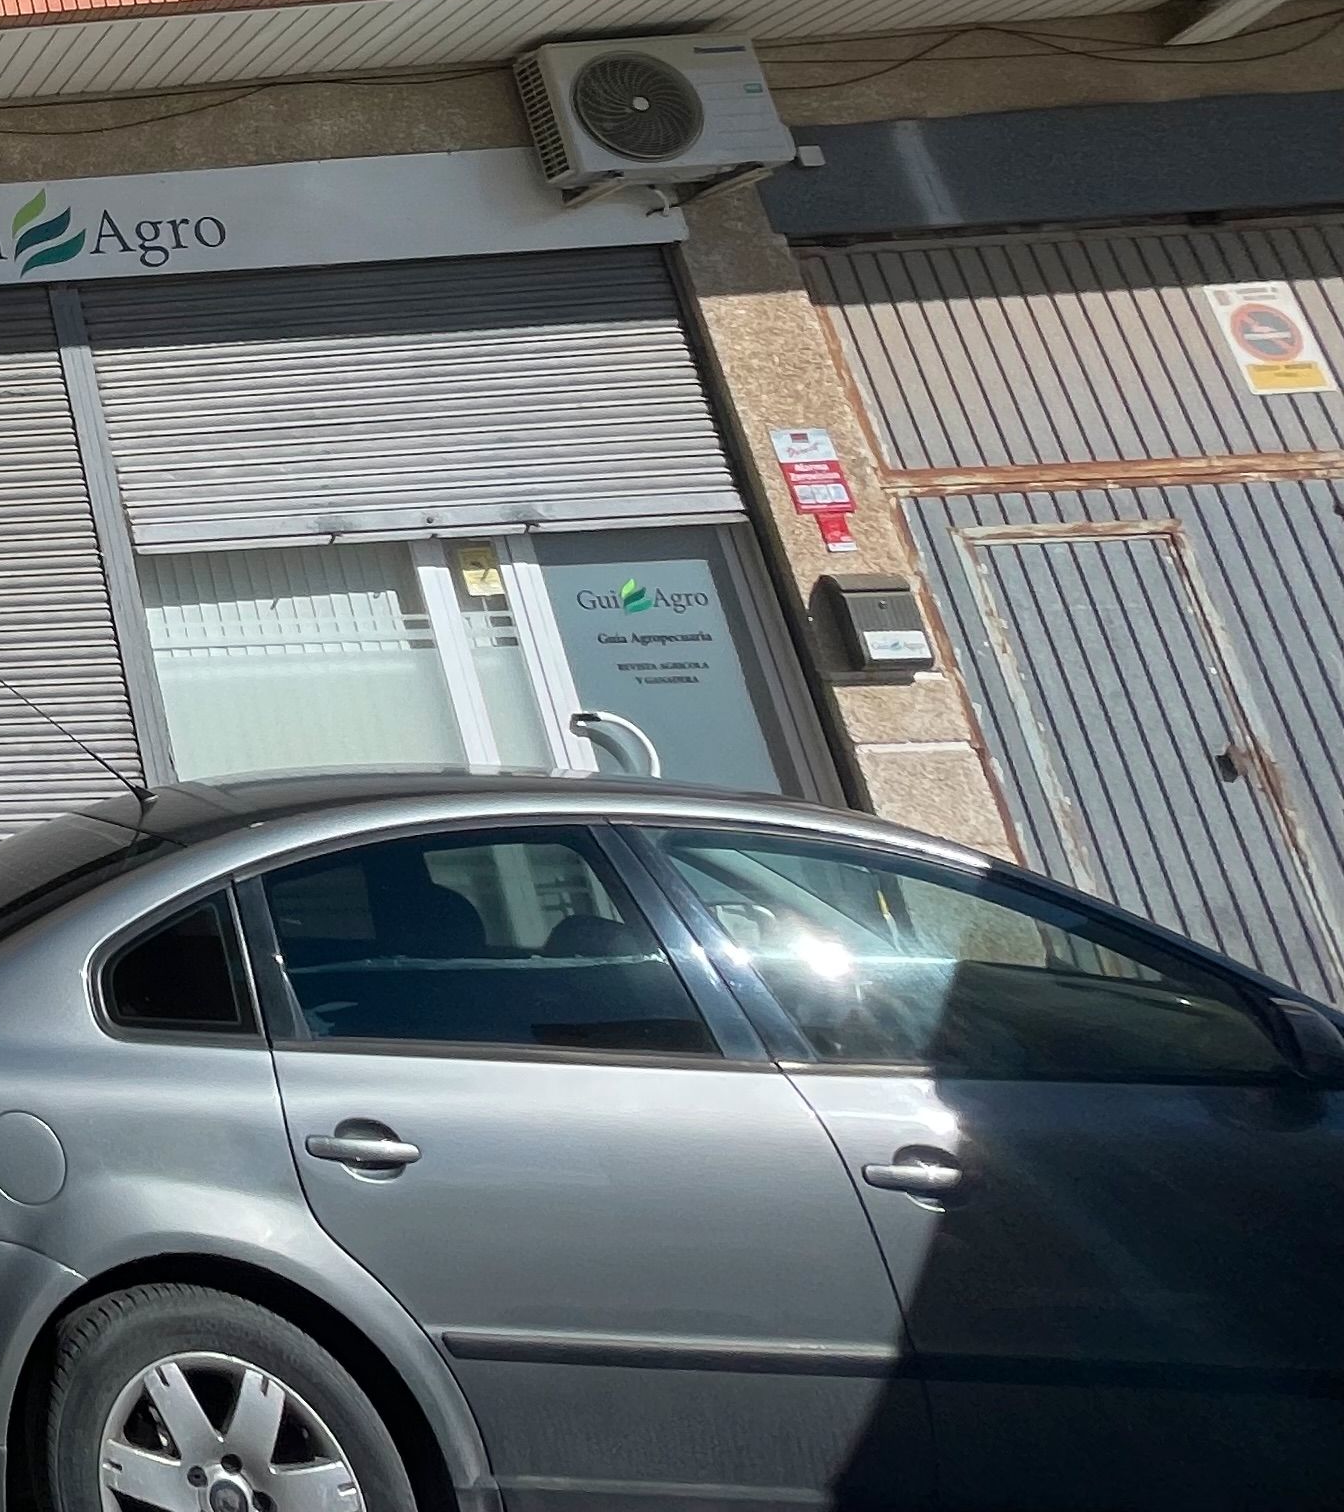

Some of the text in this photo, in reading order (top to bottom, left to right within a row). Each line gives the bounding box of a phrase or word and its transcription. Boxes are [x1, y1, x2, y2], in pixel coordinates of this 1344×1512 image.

[89, 209, 226, 268] Agro
[653, 588, 709, 614] Agro
[631, 631, 712, 646] Agropecuaria
